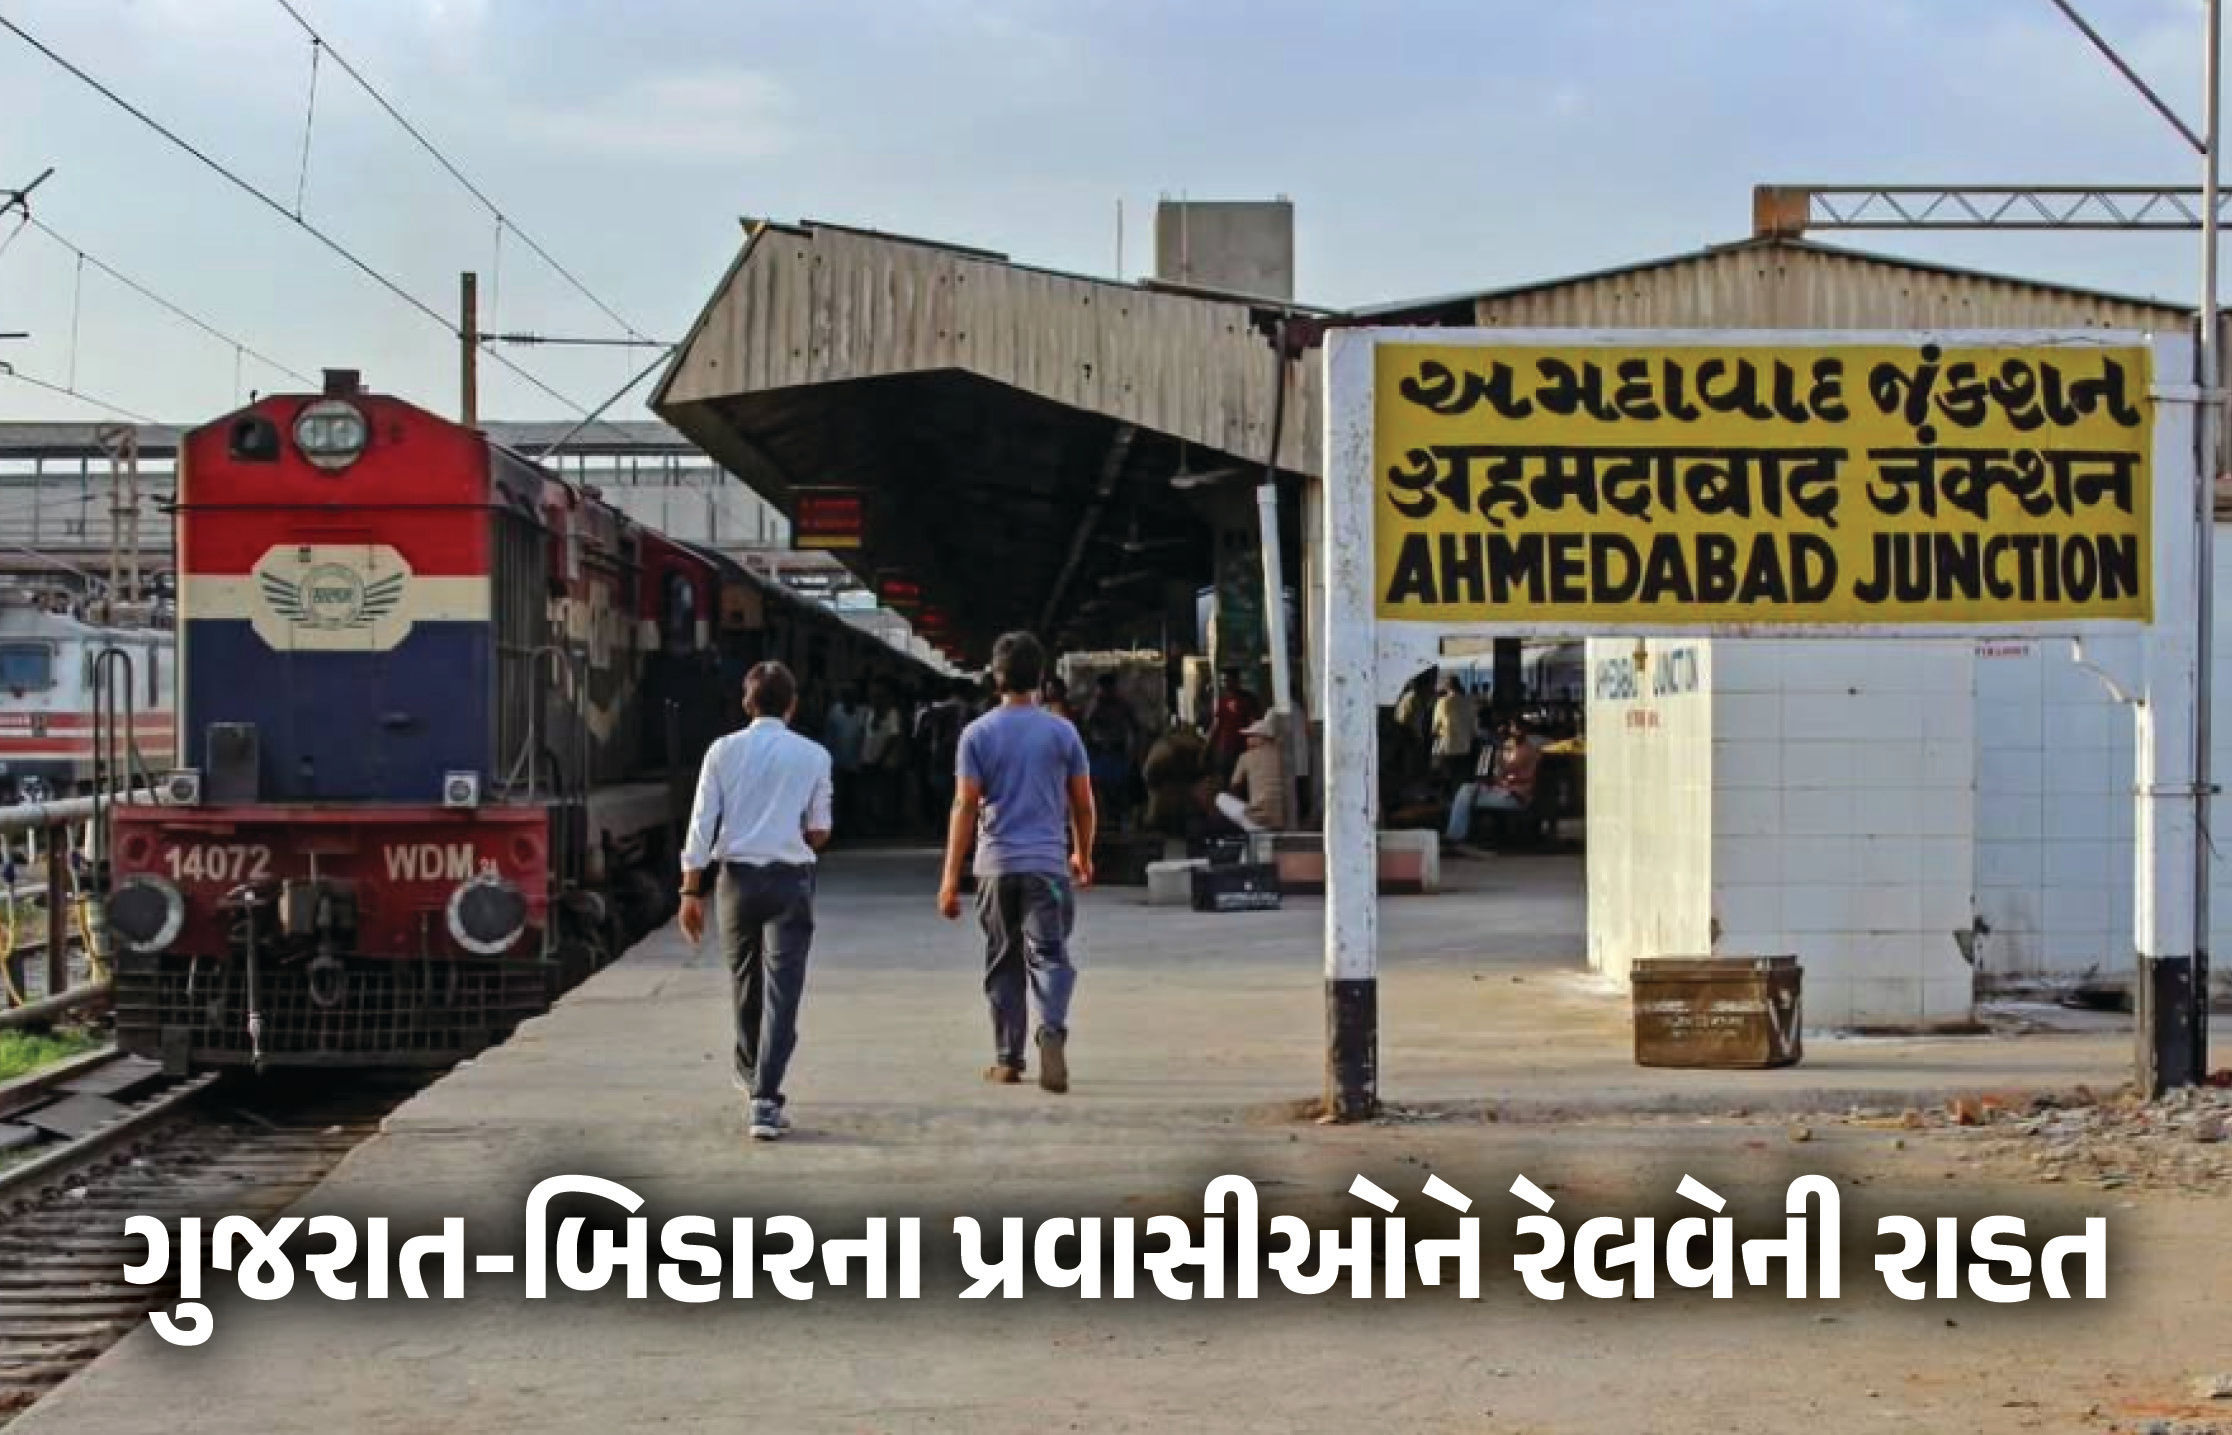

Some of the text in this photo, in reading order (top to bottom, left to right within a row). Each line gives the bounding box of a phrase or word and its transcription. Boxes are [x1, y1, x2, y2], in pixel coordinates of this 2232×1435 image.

[1399, 344, 2142, 431] અમદાવાદ જંકશન
[1387, 425, 2142, 529] अहमदाबाद जंक्शन
[1384, 531, 2140, 604] AHMEDABAD JUNCTION
[164, 844, 273, 881] 14072
